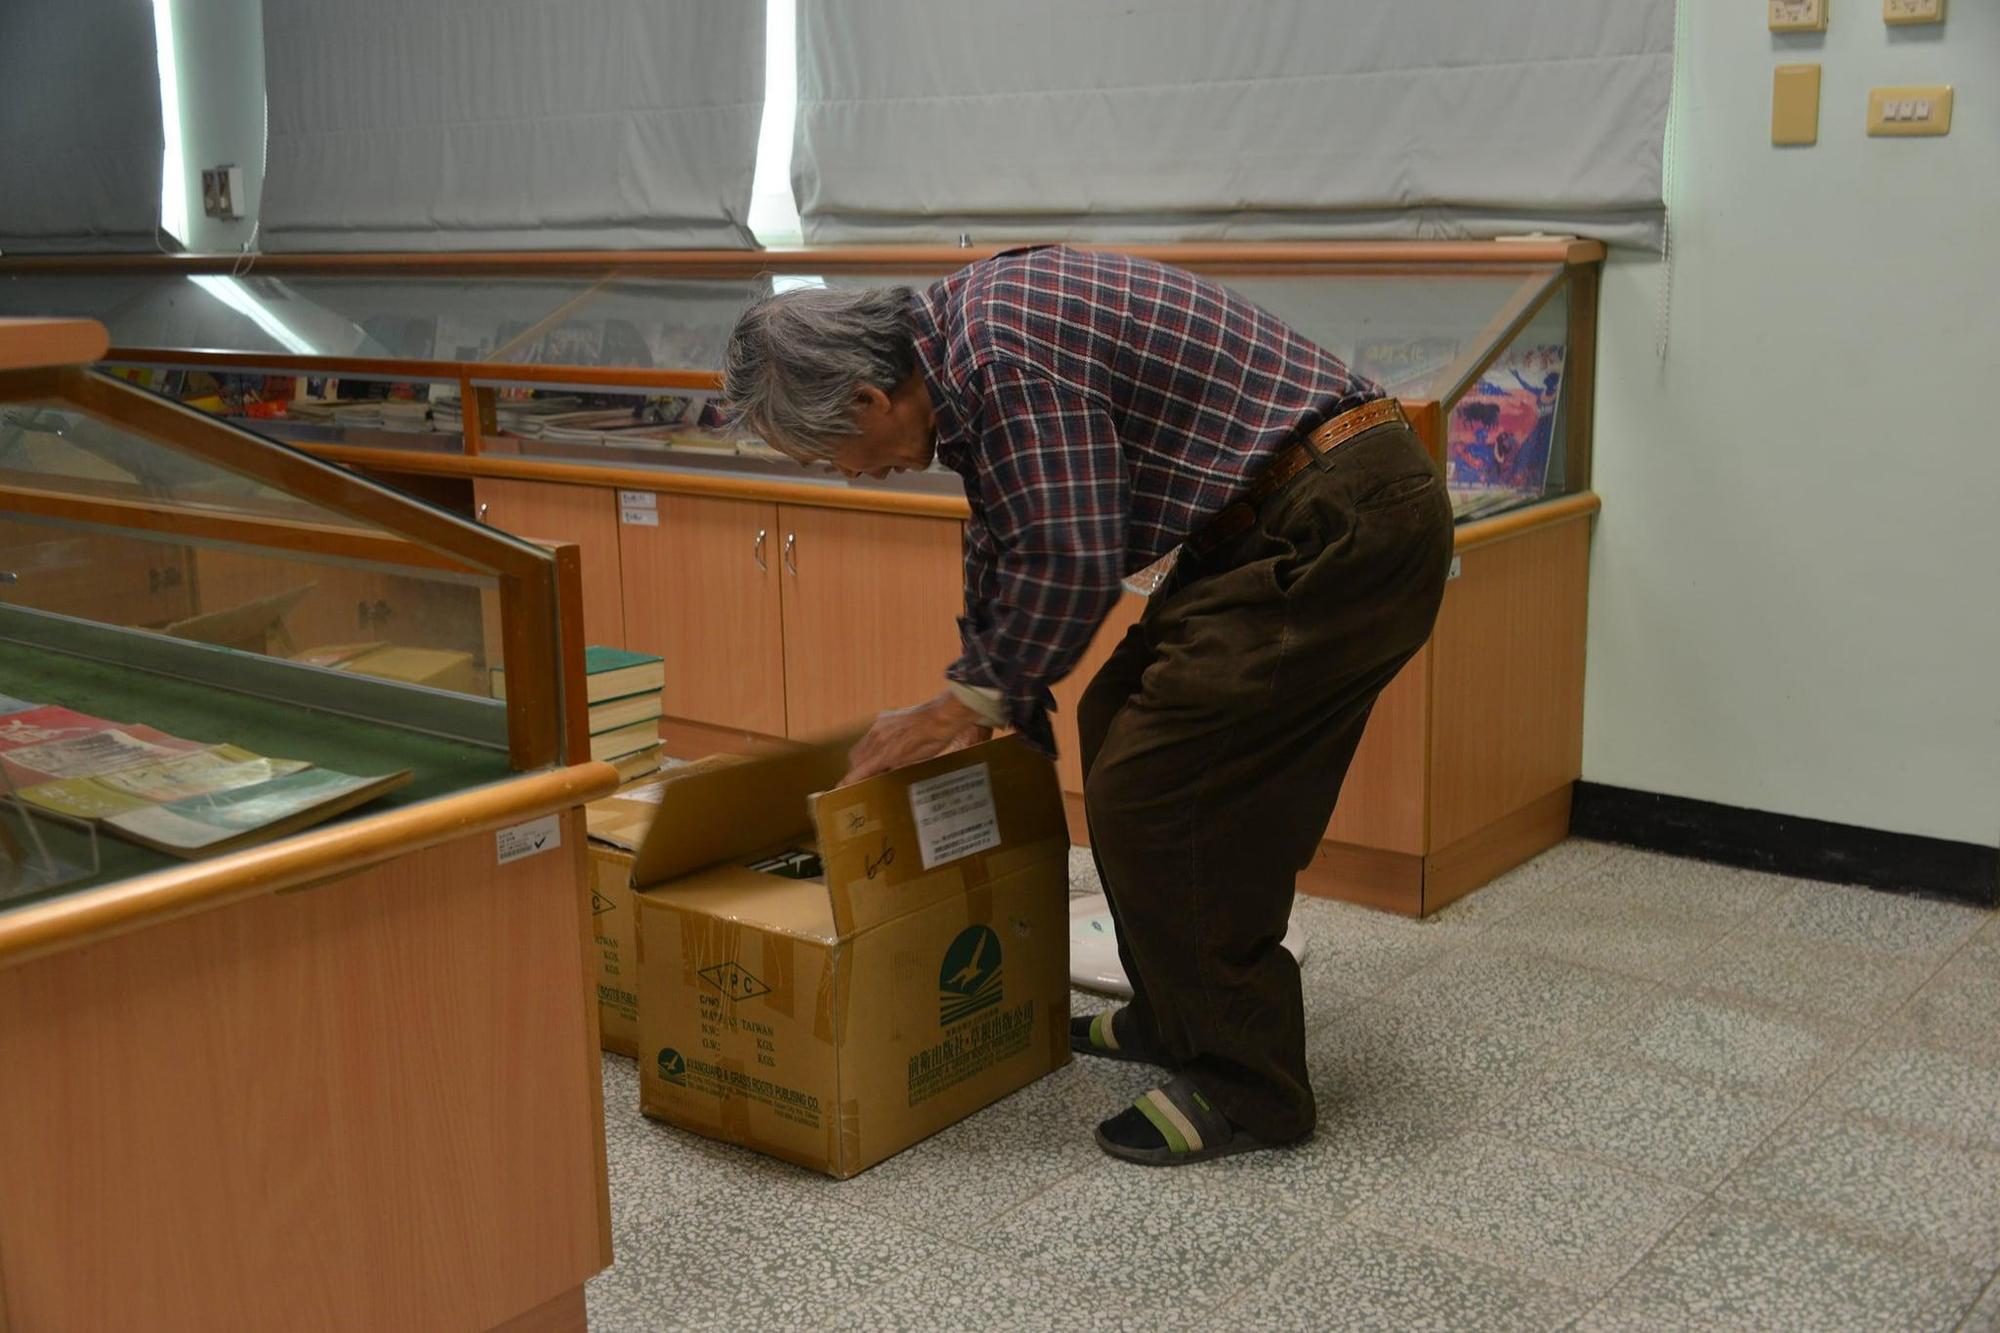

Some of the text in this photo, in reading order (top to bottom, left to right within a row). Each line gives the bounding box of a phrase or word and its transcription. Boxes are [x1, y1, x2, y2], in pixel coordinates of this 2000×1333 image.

[741, 1018, 774, 1037] TAIWAN
[730, 1069, 751, 1089] GRASS
[751, 1075, 774, 1096] ROOTS
